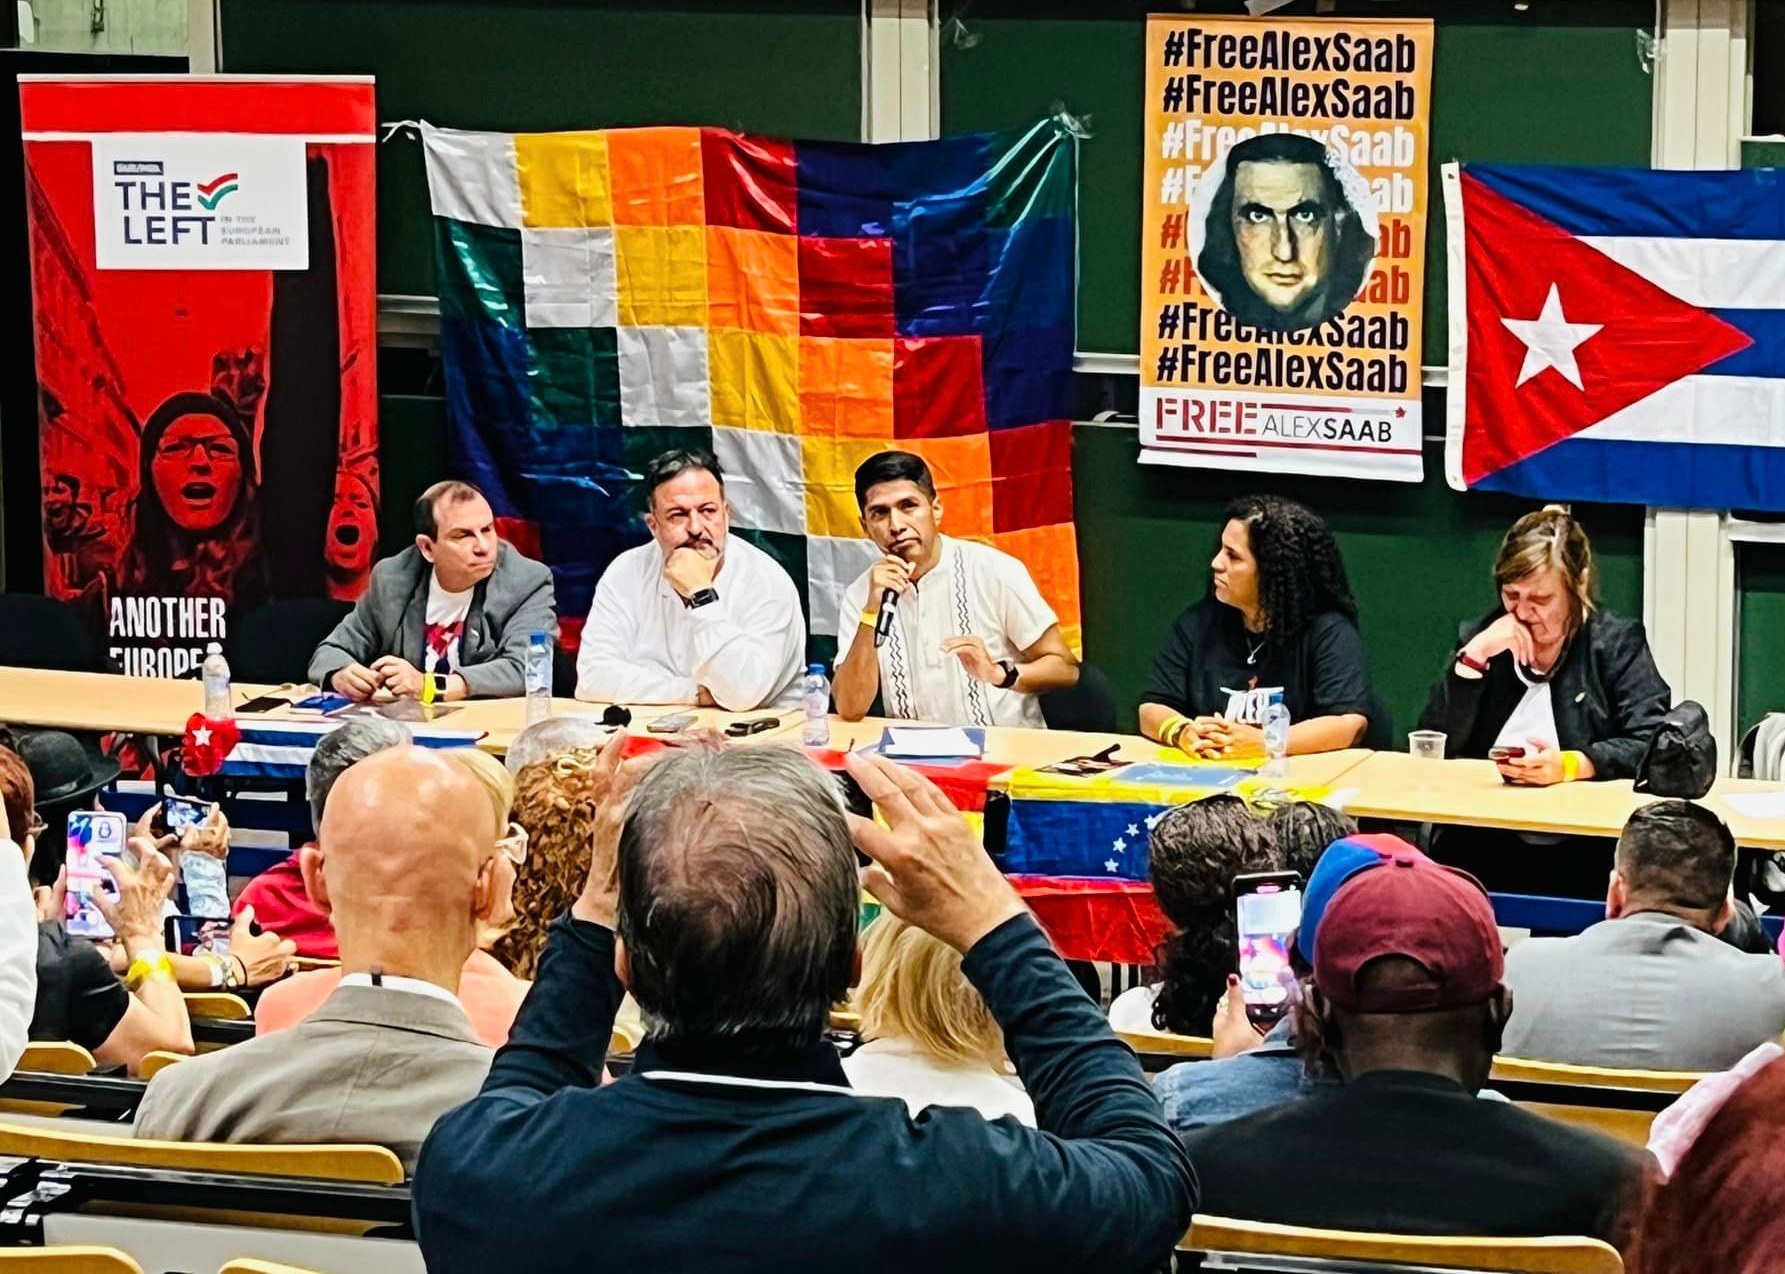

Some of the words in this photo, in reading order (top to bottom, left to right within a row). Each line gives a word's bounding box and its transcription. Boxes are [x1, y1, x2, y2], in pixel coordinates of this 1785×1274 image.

[1163, 28, 1416, 73] #FreeAlexSaab
[1163, 74, 1415, 120] #FreeAlexSaab
[1161, 119, 1415, 168] #FreSaab
[114, 181, 192, 211] THE
[123, 216, 215, 245] LEFT
[1158, 302, 1409, 350] #FrexSaab
[1156, 344, 1408, 393] #FreeAlexSaab
[1156, 397, 1257, 435] FREE
[1261, 413, 1392, 443] ALEXSAAB
[109, 596, 226, 639] ANOTHER
[109, 647, 205, 679] UROPE
